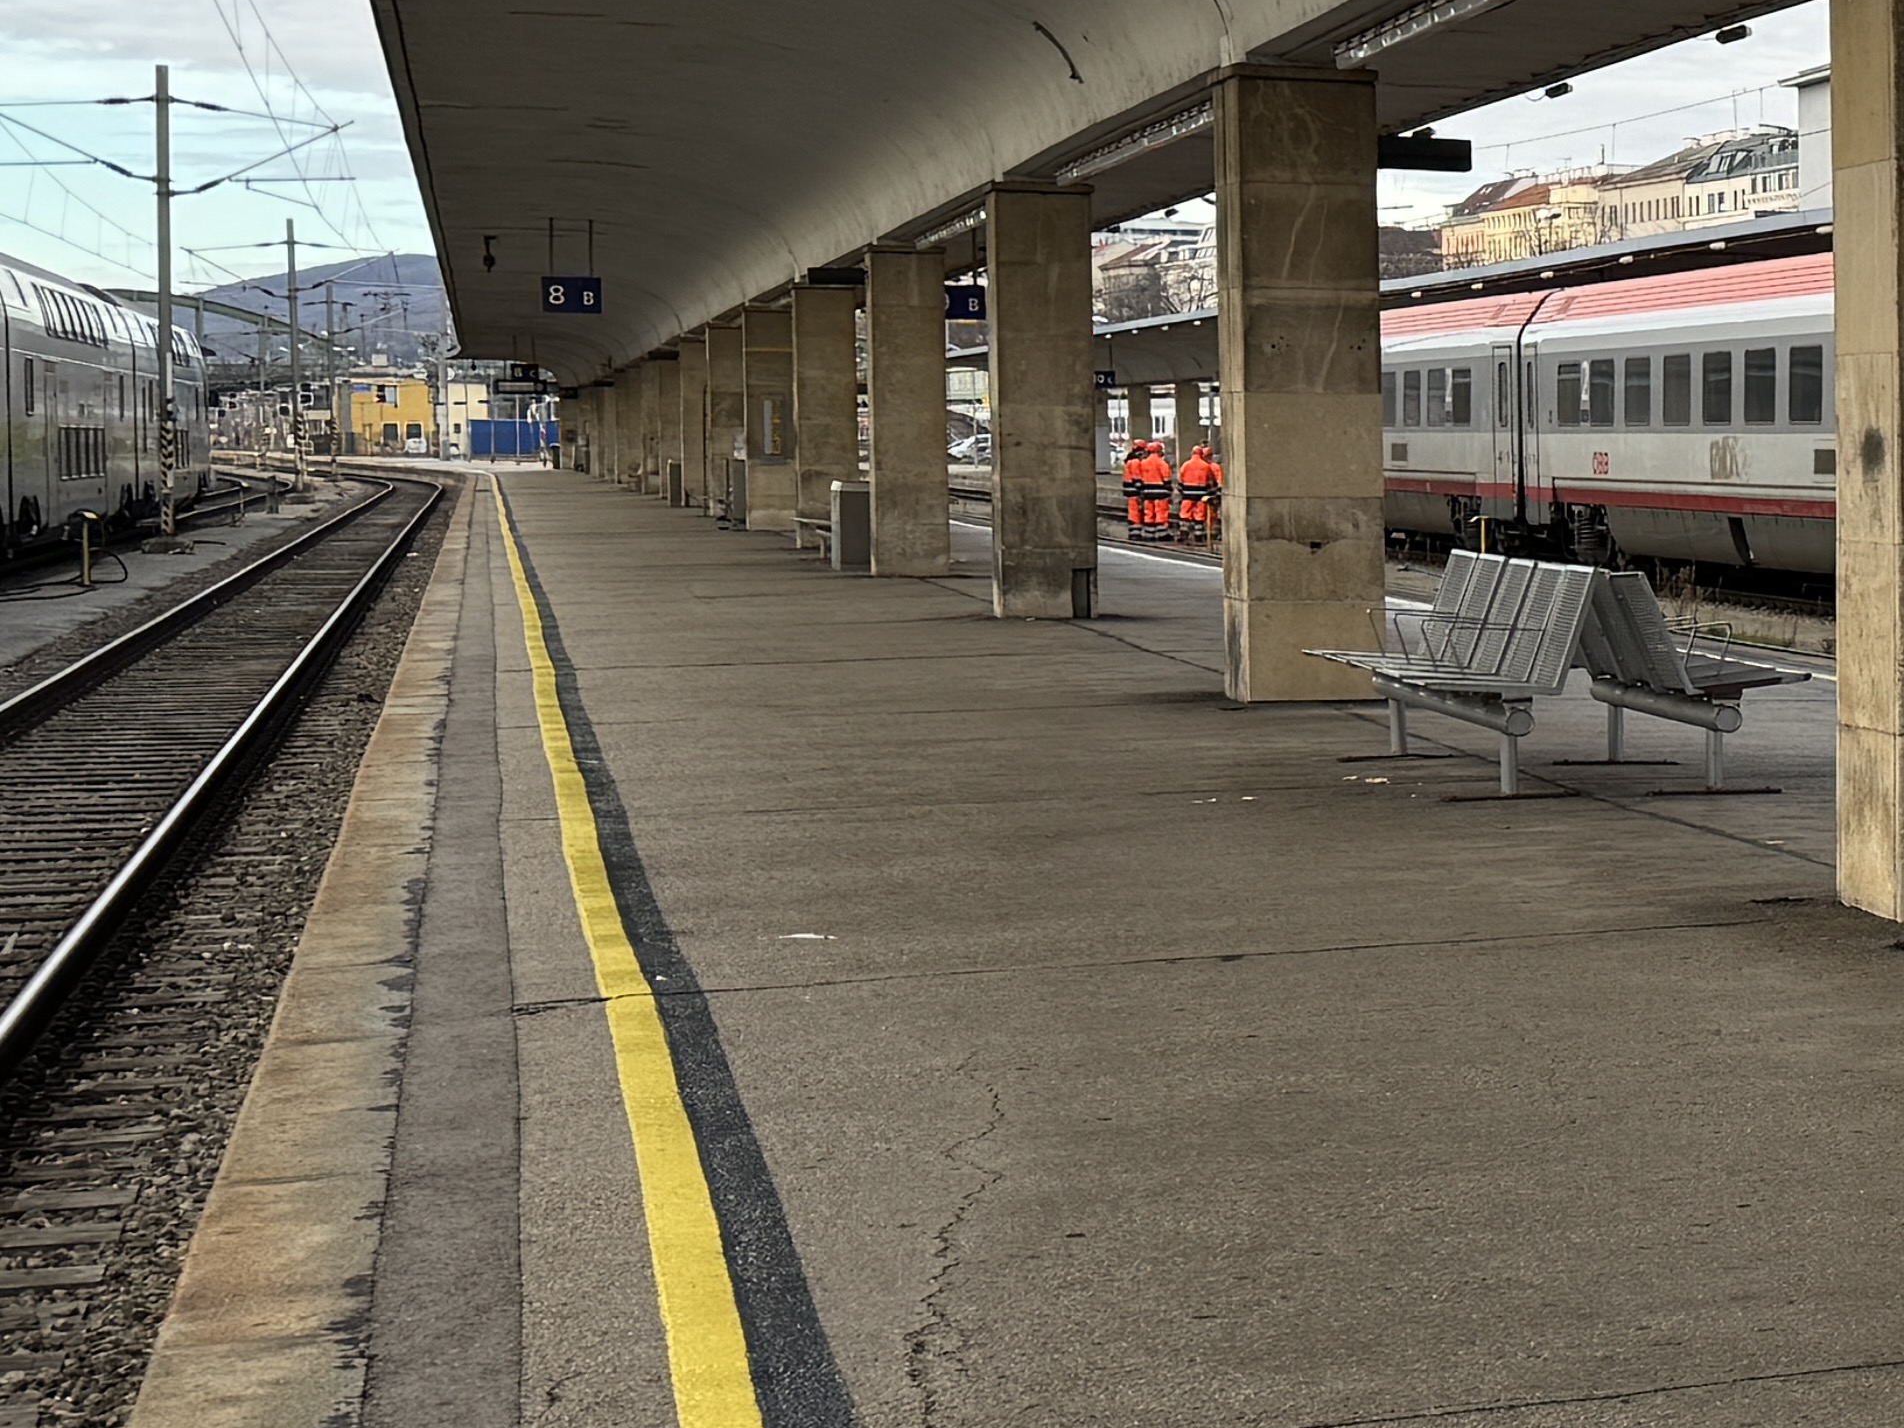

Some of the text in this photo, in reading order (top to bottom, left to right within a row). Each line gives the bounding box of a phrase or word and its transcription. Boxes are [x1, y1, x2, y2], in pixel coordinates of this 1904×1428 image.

[549, 285, 594, 305] 8 B
[968, 297, 979, 312] B
